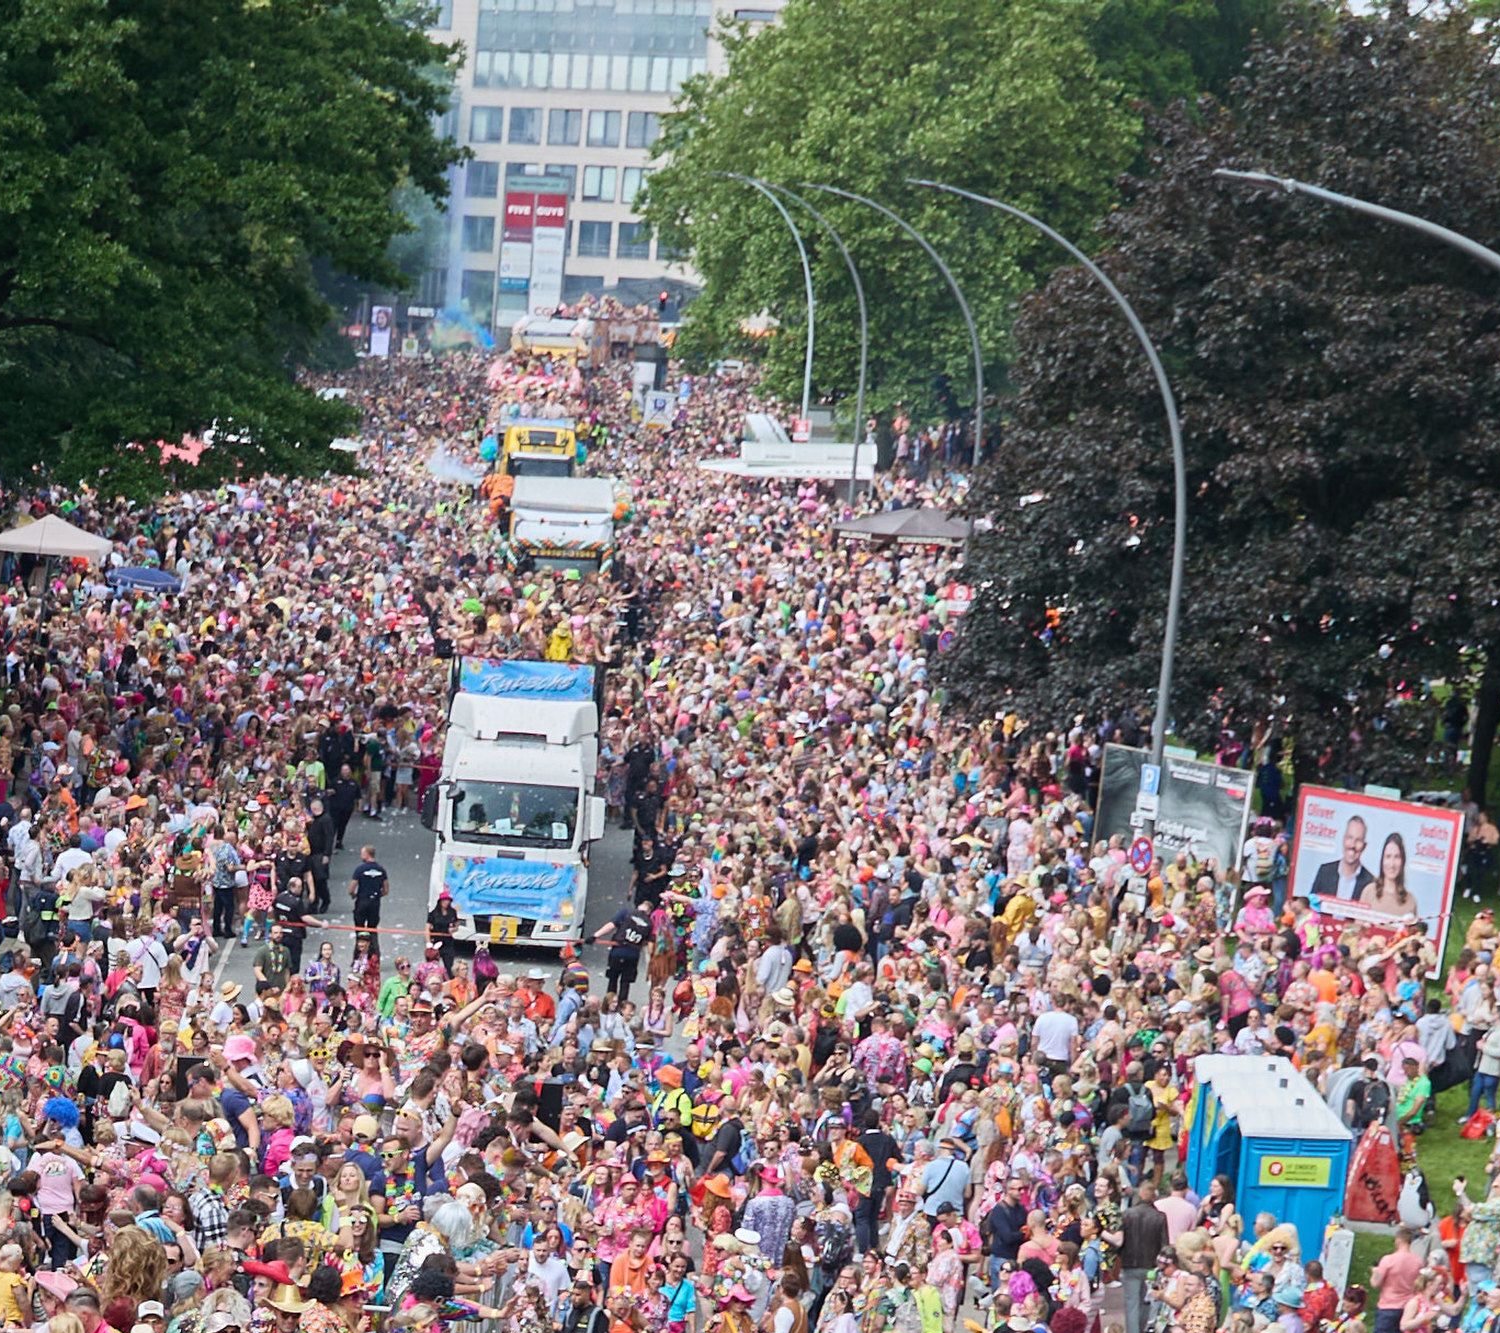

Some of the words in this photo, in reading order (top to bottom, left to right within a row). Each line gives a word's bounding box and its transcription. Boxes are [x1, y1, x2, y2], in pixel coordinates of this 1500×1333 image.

[507, 204, 532, 216] FIVE
[536, 205, 565, 217] GUYS
[499, 927, 508, 943] 2
